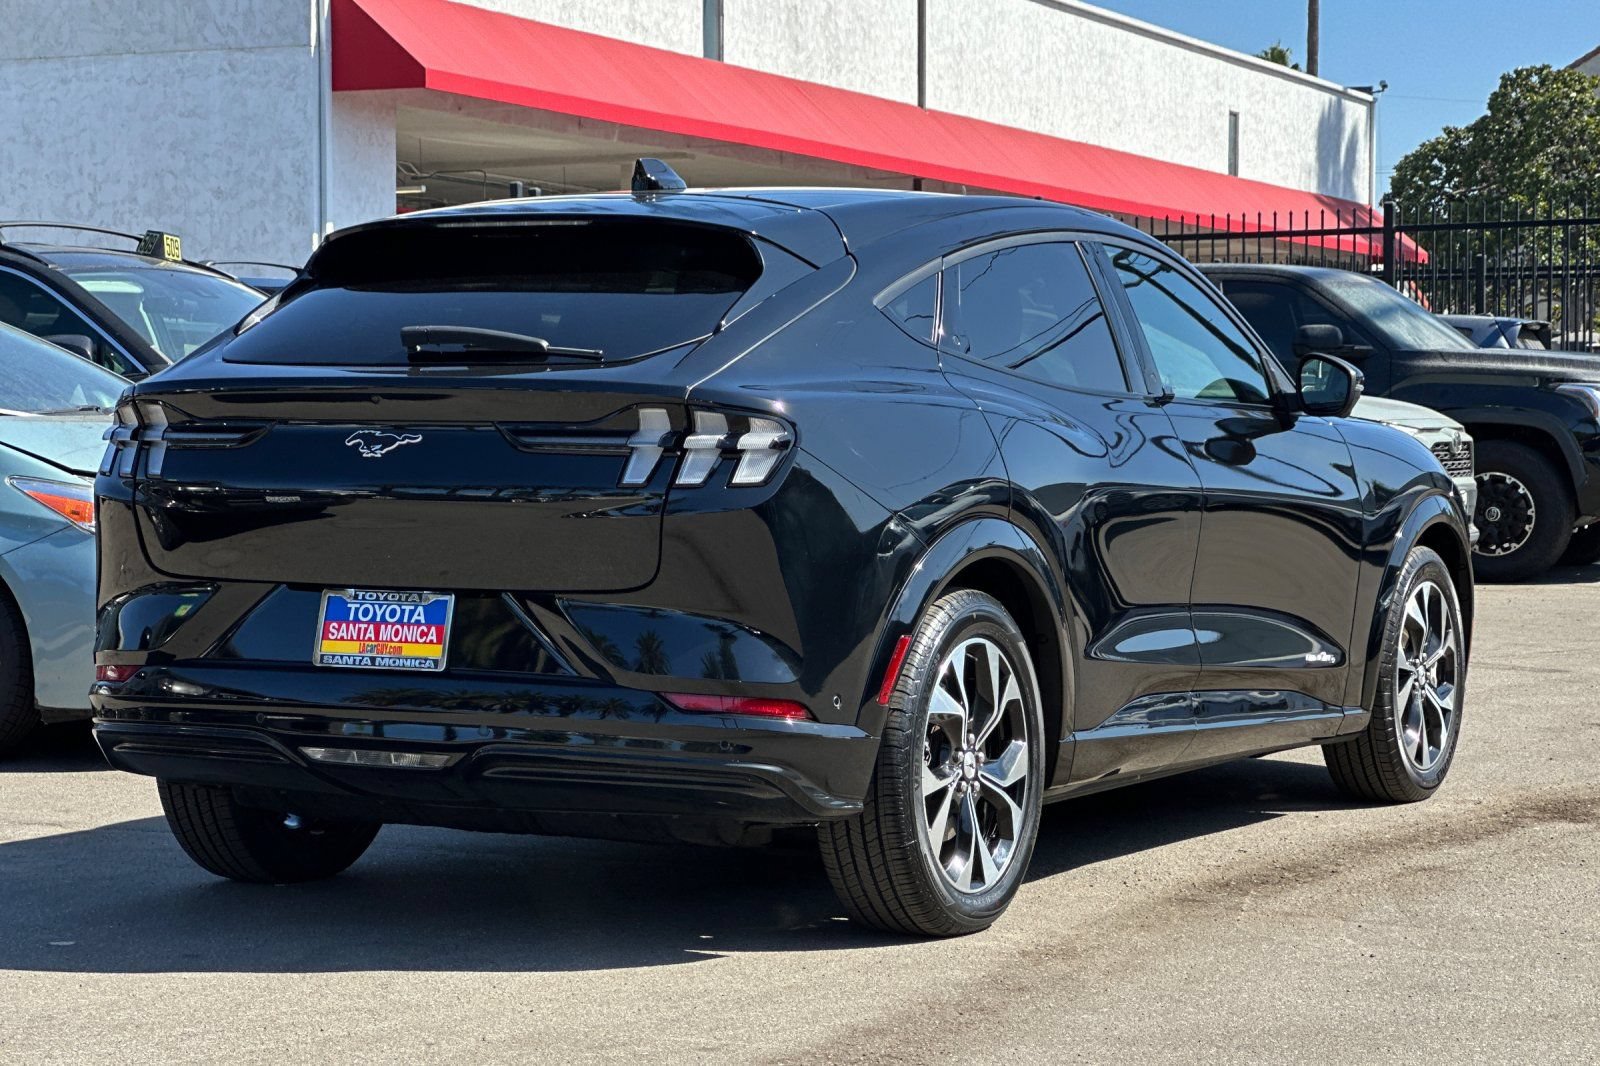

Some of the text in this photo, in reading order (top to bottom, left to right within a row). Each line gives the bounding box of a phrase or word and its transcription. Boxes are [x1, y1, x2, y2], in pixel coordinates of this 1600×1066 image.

[165, 236, 180, 259] 509
[356, 591, 420, 602] TOYOTA
[347, 603, 426, 624] TOYOTA
[328, 622, 437, 643] SANTA MONICA
[358, 642, 403, 655] LAcarGUY.com
[323, 655, 435, 669] SANTA MONICA
